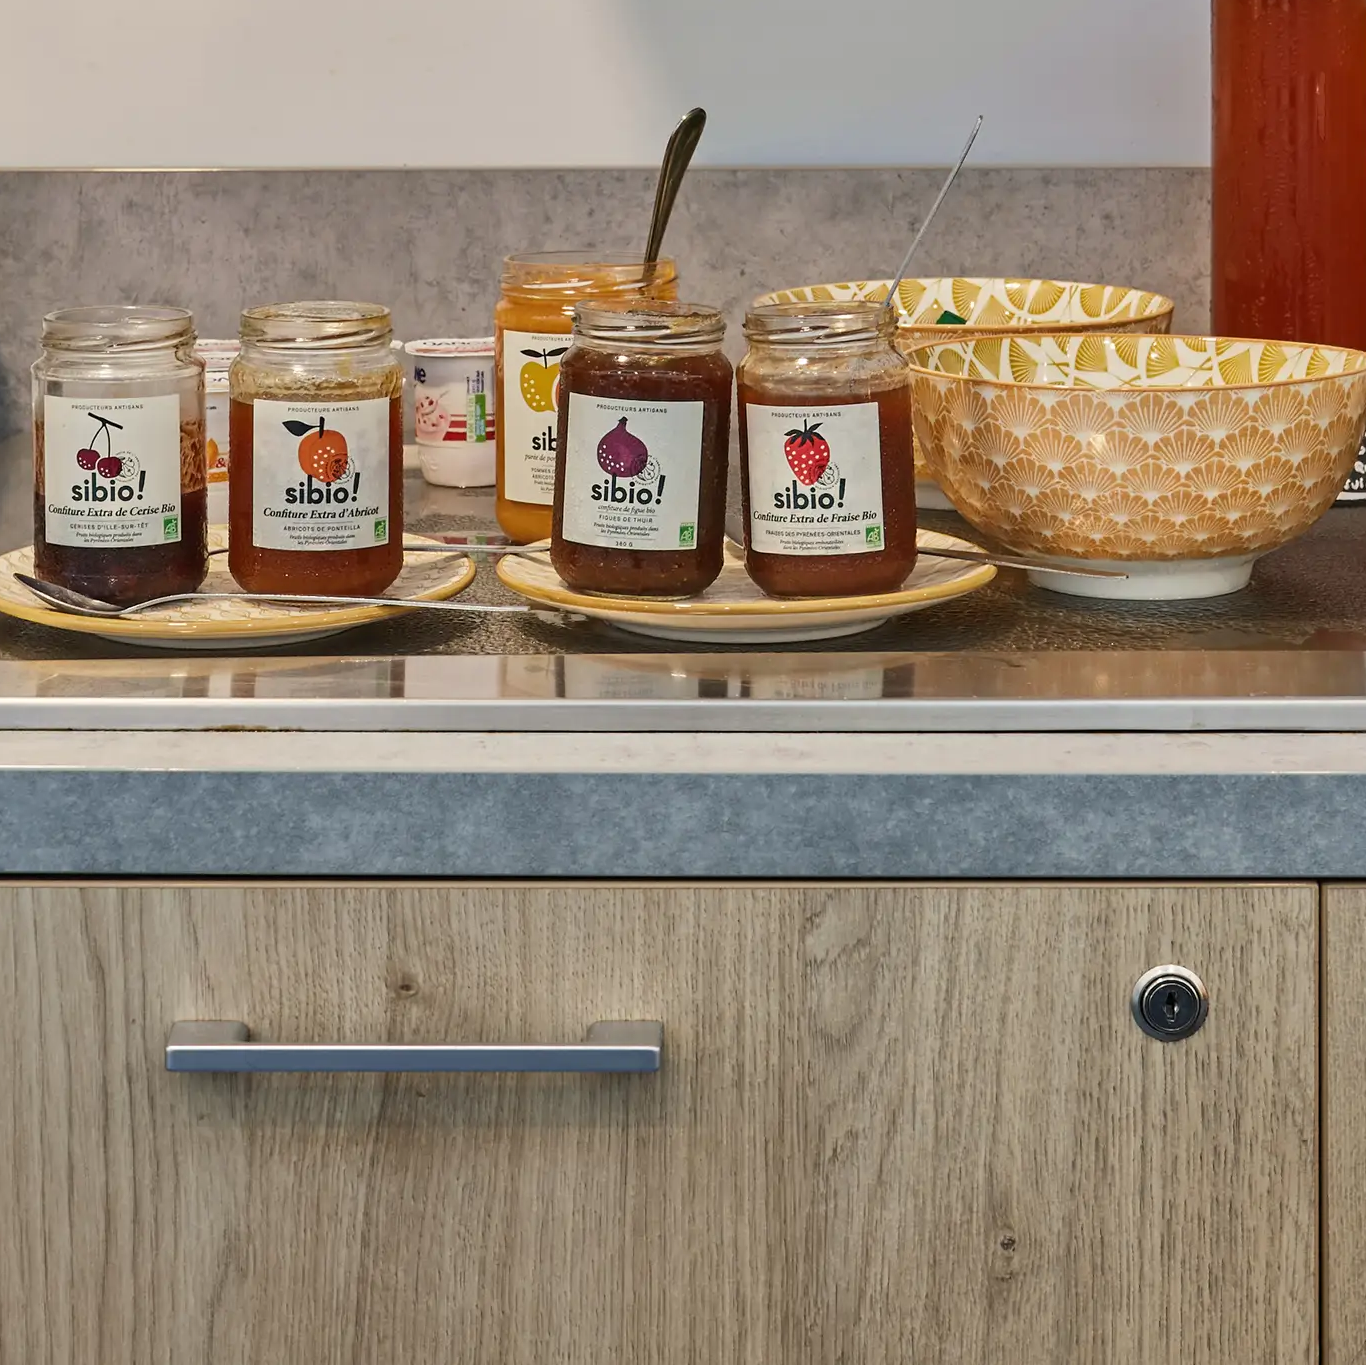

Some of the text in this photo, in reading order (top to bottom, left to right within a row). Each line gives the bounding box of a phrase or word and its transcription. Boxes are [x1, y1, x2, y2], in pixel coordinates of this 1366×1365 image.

[597, 403, 637, 413] PRODUCTEURS
[531, 426, 557, 451] sib
[215, 457, 227, 469] &
[71, 470, 146, 502] sibio!
[285, 472, 360, 504] sibio!
[591, 473, 666, 505] sibio!
[774, 478, 846, 510] sibio!
[48, 503, 176, 517] Confiture Extra de Cerise Bio
[263, 506, 379, 519] Confiture Extra d'Abricot
[598, 504, 656, 515] confiture de figue bio
[598, 514, 621, 522] FIGUES
[753, 510, 877, 523] Confiture Extra de Fraise Bio
[327, 524, 361, 532] PONTEILLA
